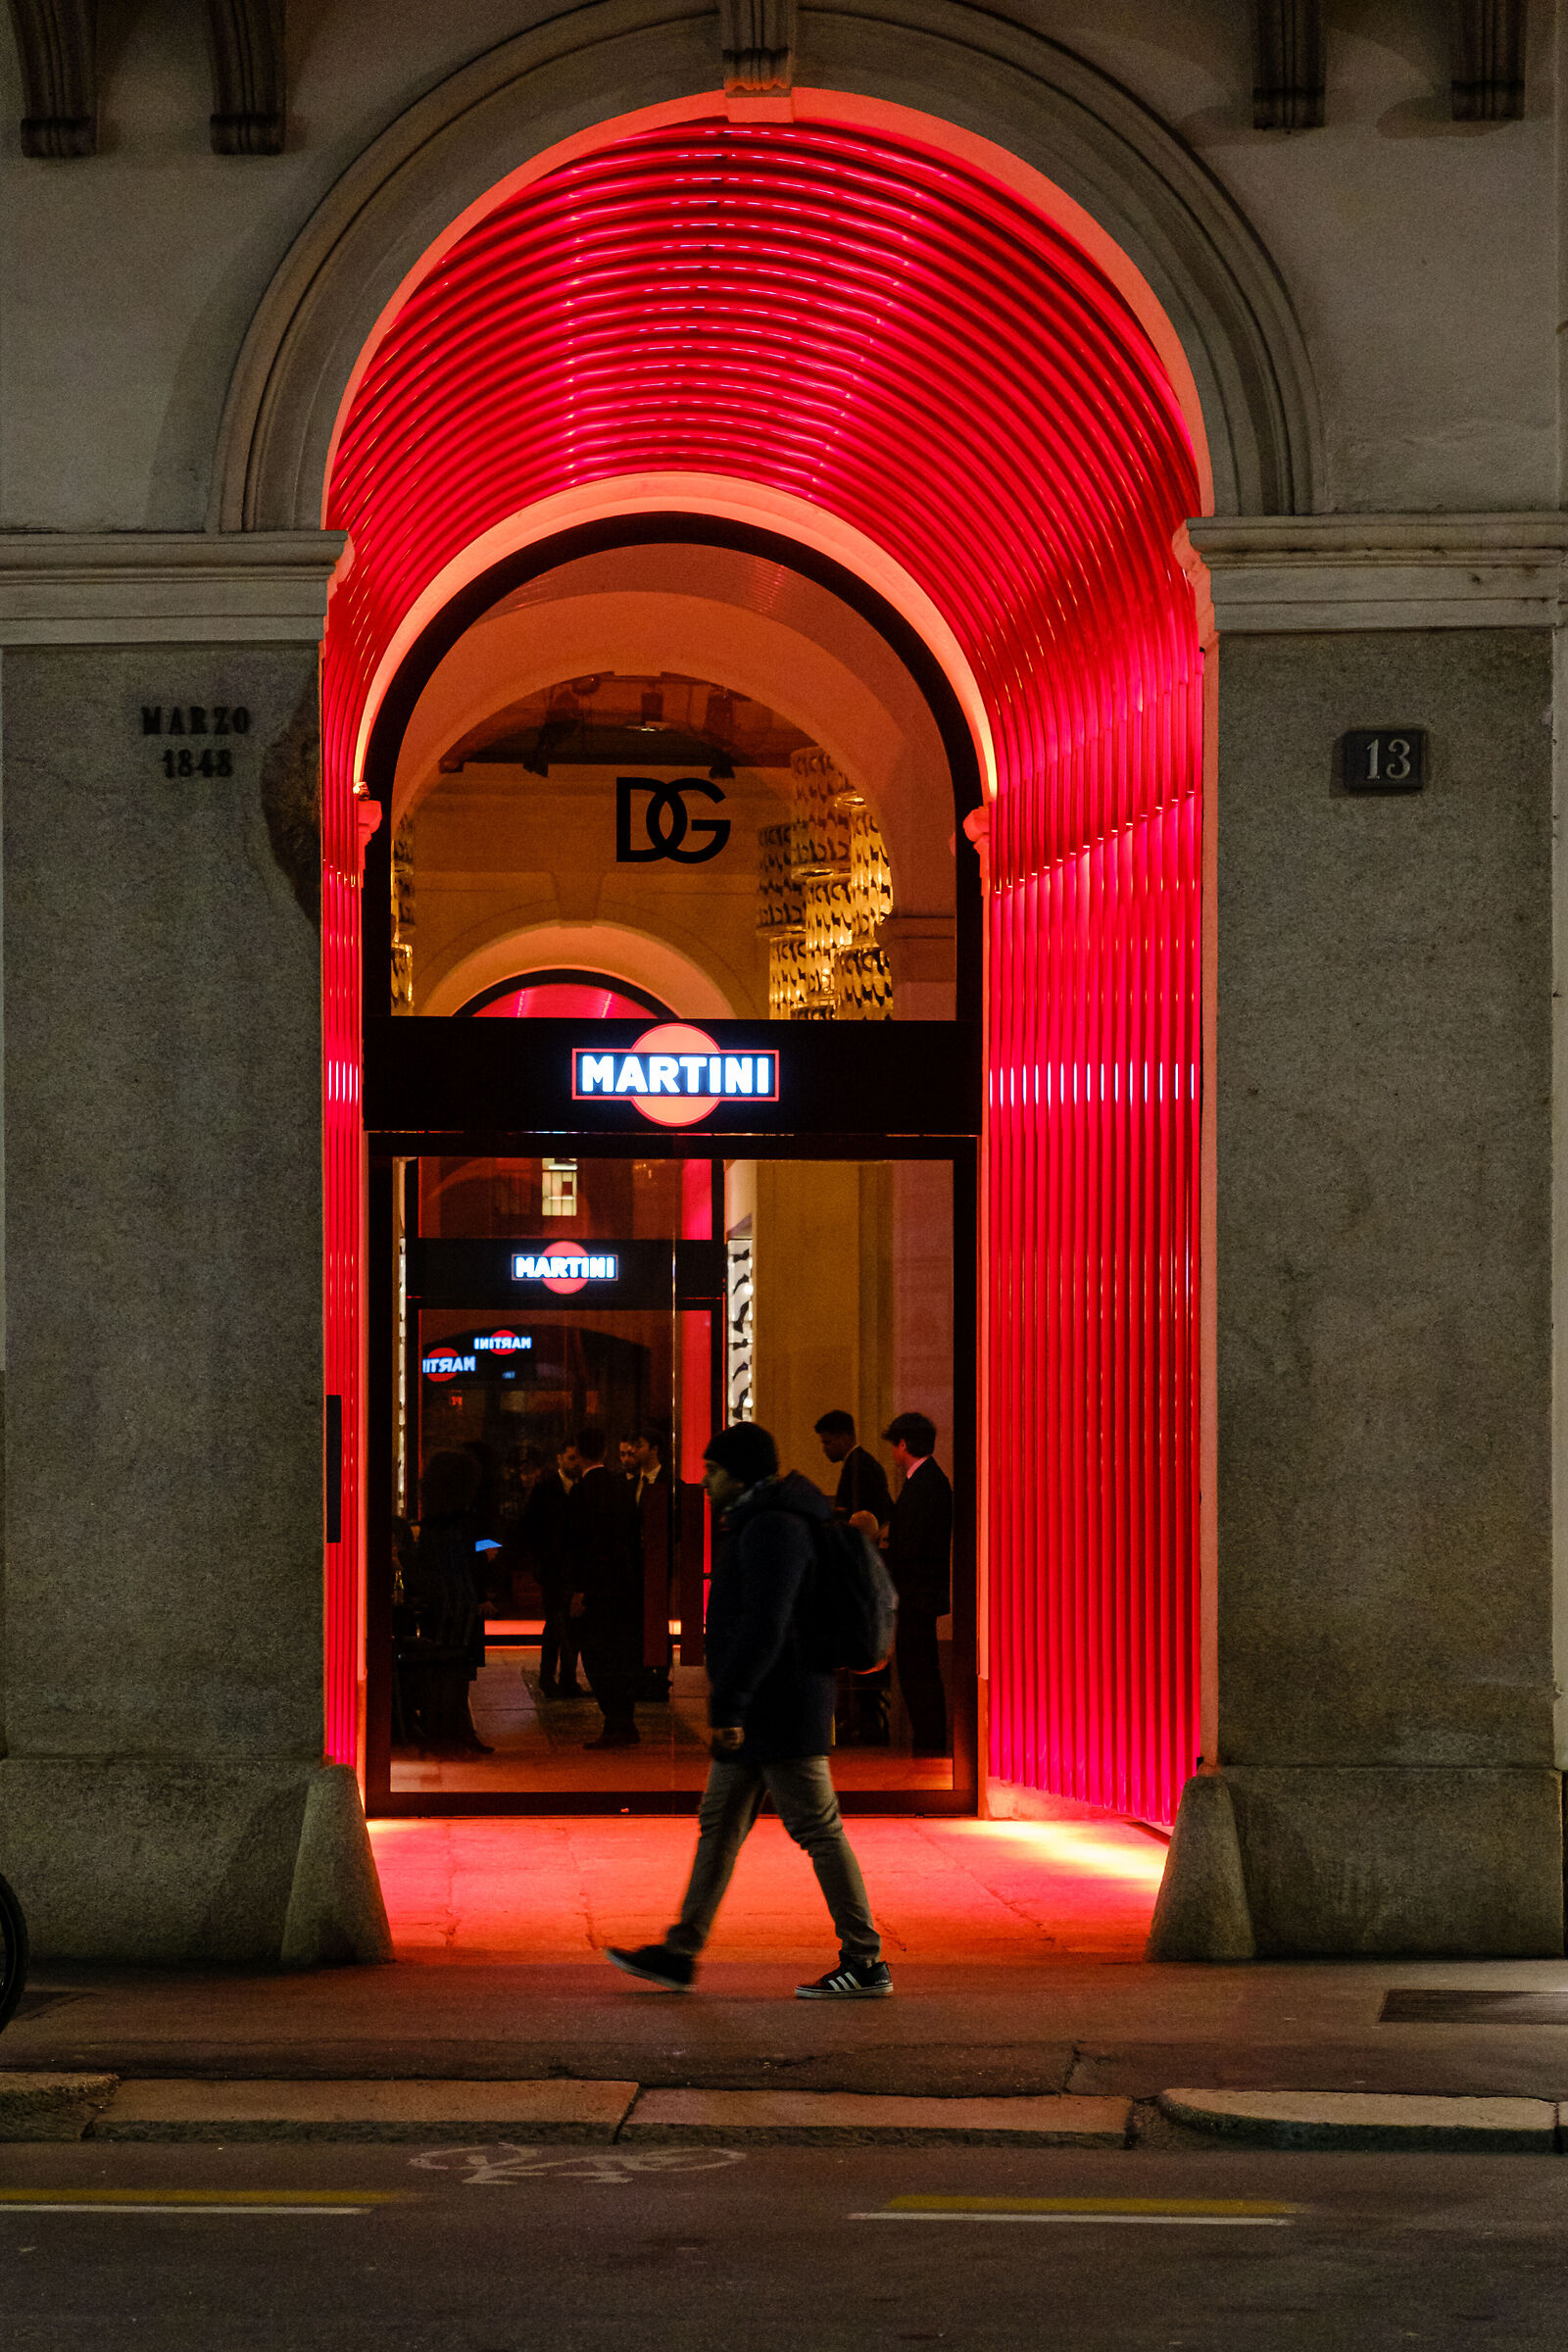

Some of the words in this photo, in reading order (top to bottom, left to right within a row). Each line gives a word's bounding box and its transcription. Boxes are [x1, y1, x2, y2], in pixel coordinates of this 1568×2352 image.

[140, 706, 252, 735] MARZO
[162, 748, 234, 778] 1848
[1364, 738, 1411, 780] 13
[616, 776, 731, 863] DG
[581, 1054, 770, 1094] MARTINI
[514, 1255, 615, 1279] MARTINI
